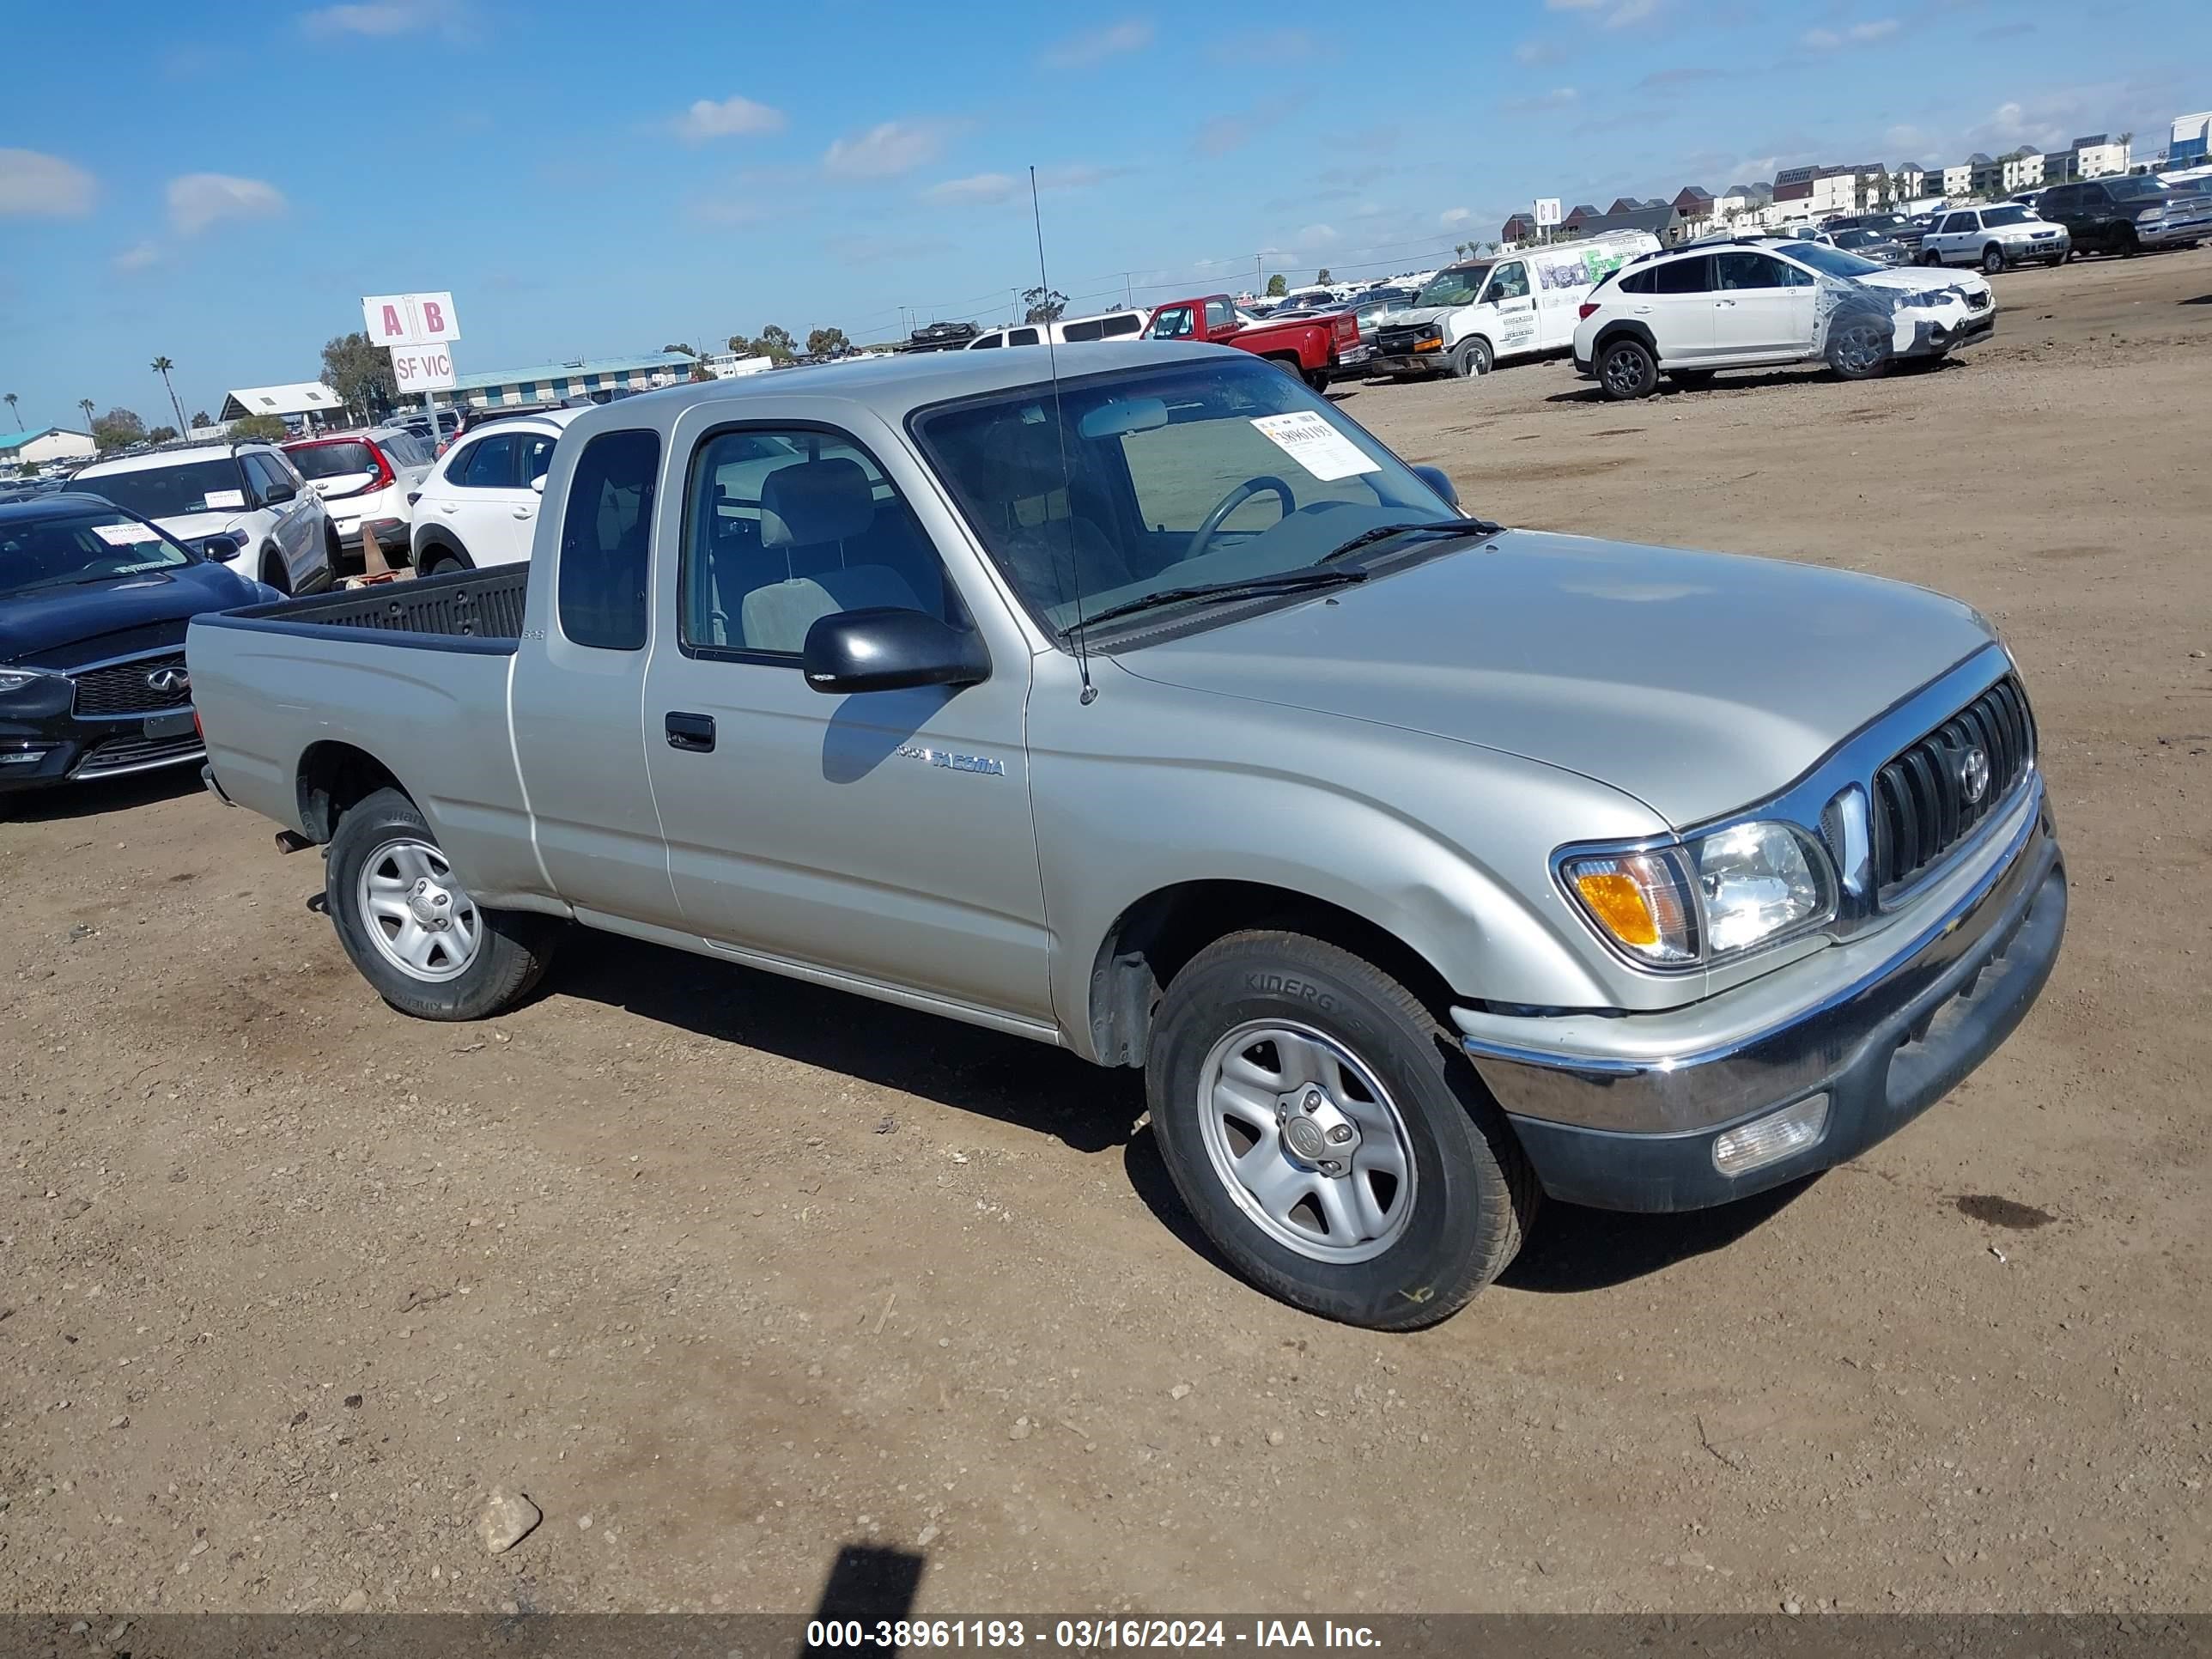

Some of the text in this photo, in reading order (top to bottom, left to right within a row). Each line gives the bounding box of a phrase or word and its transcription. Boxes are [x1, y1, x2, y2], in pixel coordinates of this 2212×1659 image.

[1552, 203, 1558, 220] D
[382, 301, 445, 337] A B
[397, 354, 450, 380] SF VIC
[1276, 425, 1334, 444] 38961193
